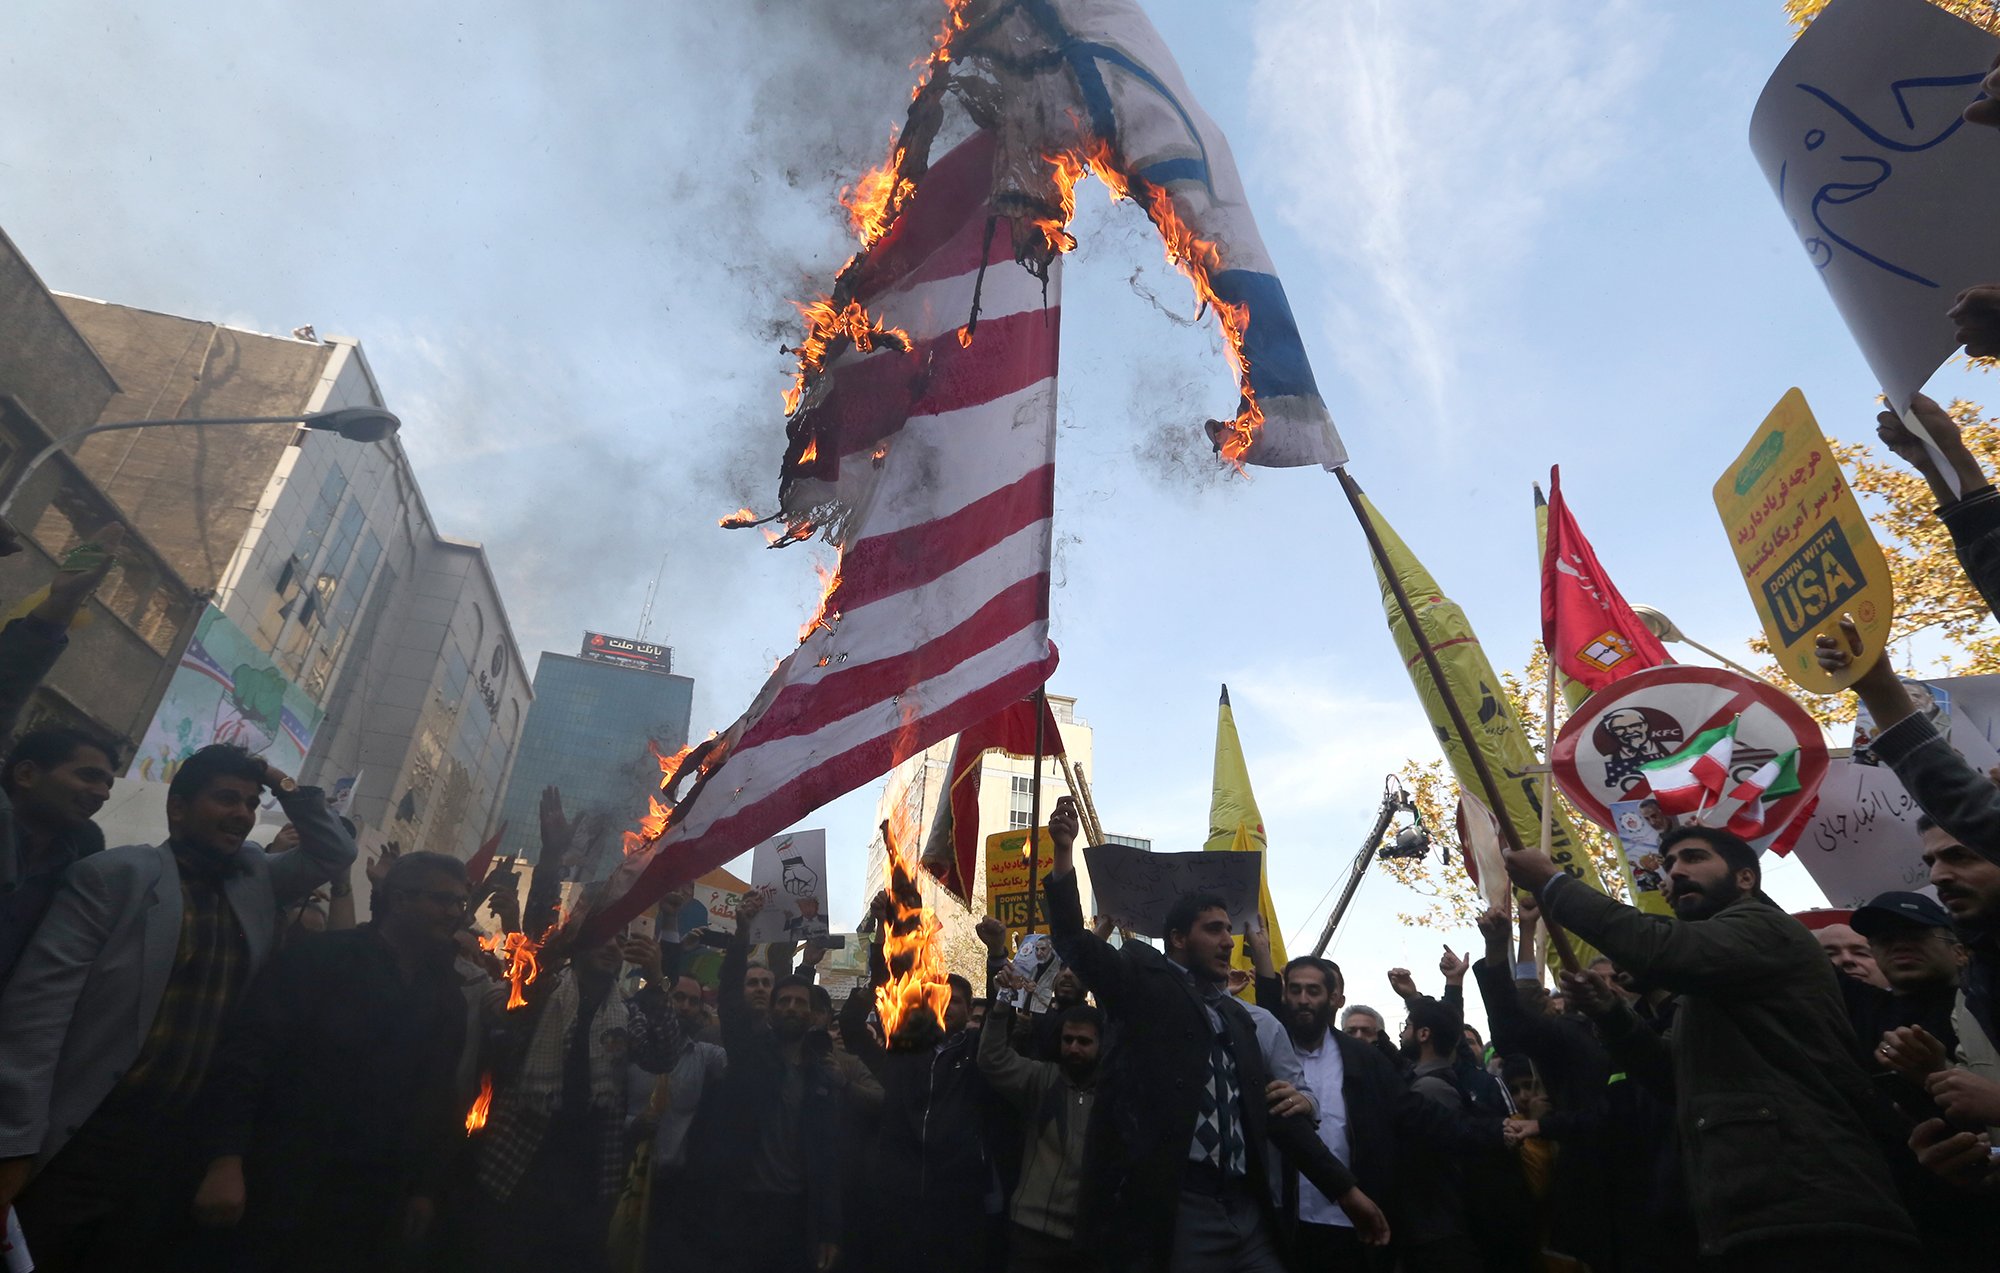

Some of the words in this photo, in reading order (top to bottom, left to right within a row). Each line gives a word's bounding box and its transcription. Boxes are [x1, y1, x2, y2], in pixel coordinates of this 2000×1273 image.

[1789, 467, 1807, 487] چه
[1808, 451, 1821, 479] هر
[1763, 478, 1789, 512] فریاد
[1832, 476, 1844, 503] بر
[1814, 491, 1828, 519] سر
[1737, 510, 1763, 544] دارید
[1772, 498, 1808, 547] آمریکا
[1746, 541, 1777, 578] بکشید
[1769, 558, 1803, 594] DOWN
[1802, 528, 1836, 563] WITH
[1775, 550, 1857, 633] USA
[609, 639, 633, 650] ملت
[1651, 728, 1680, 738] KFC
[1000, 895, 1022, 903] DOWN
